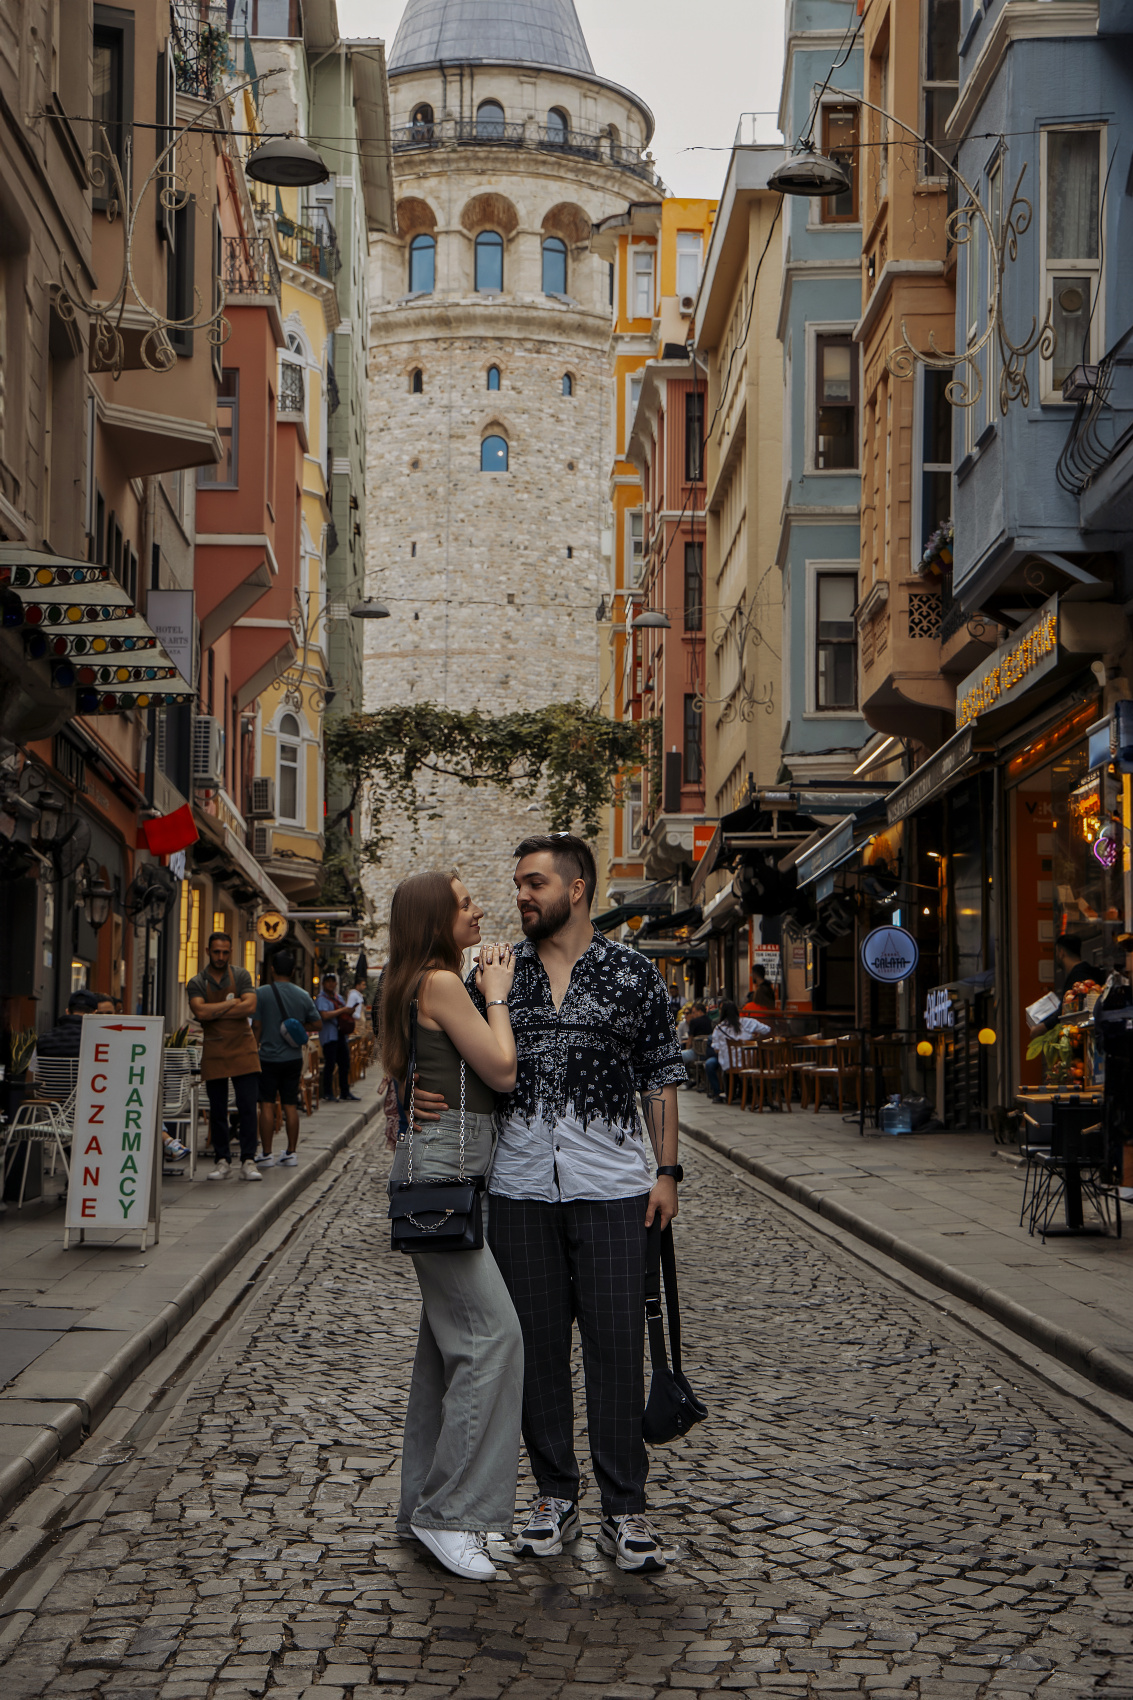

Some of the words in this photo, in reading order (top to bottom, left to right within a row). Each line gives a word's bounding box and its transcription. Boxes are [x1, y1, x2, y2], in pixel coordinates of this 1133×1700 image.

[155, 626, 184, 634] HOTEL
[168, 637, 189, 645] ARTS
[873, 957, 907, 969] GALATA
[81, 1043, 110, 1218] ECZANE
[118, 1043, 147, 1219] PHARMACY
